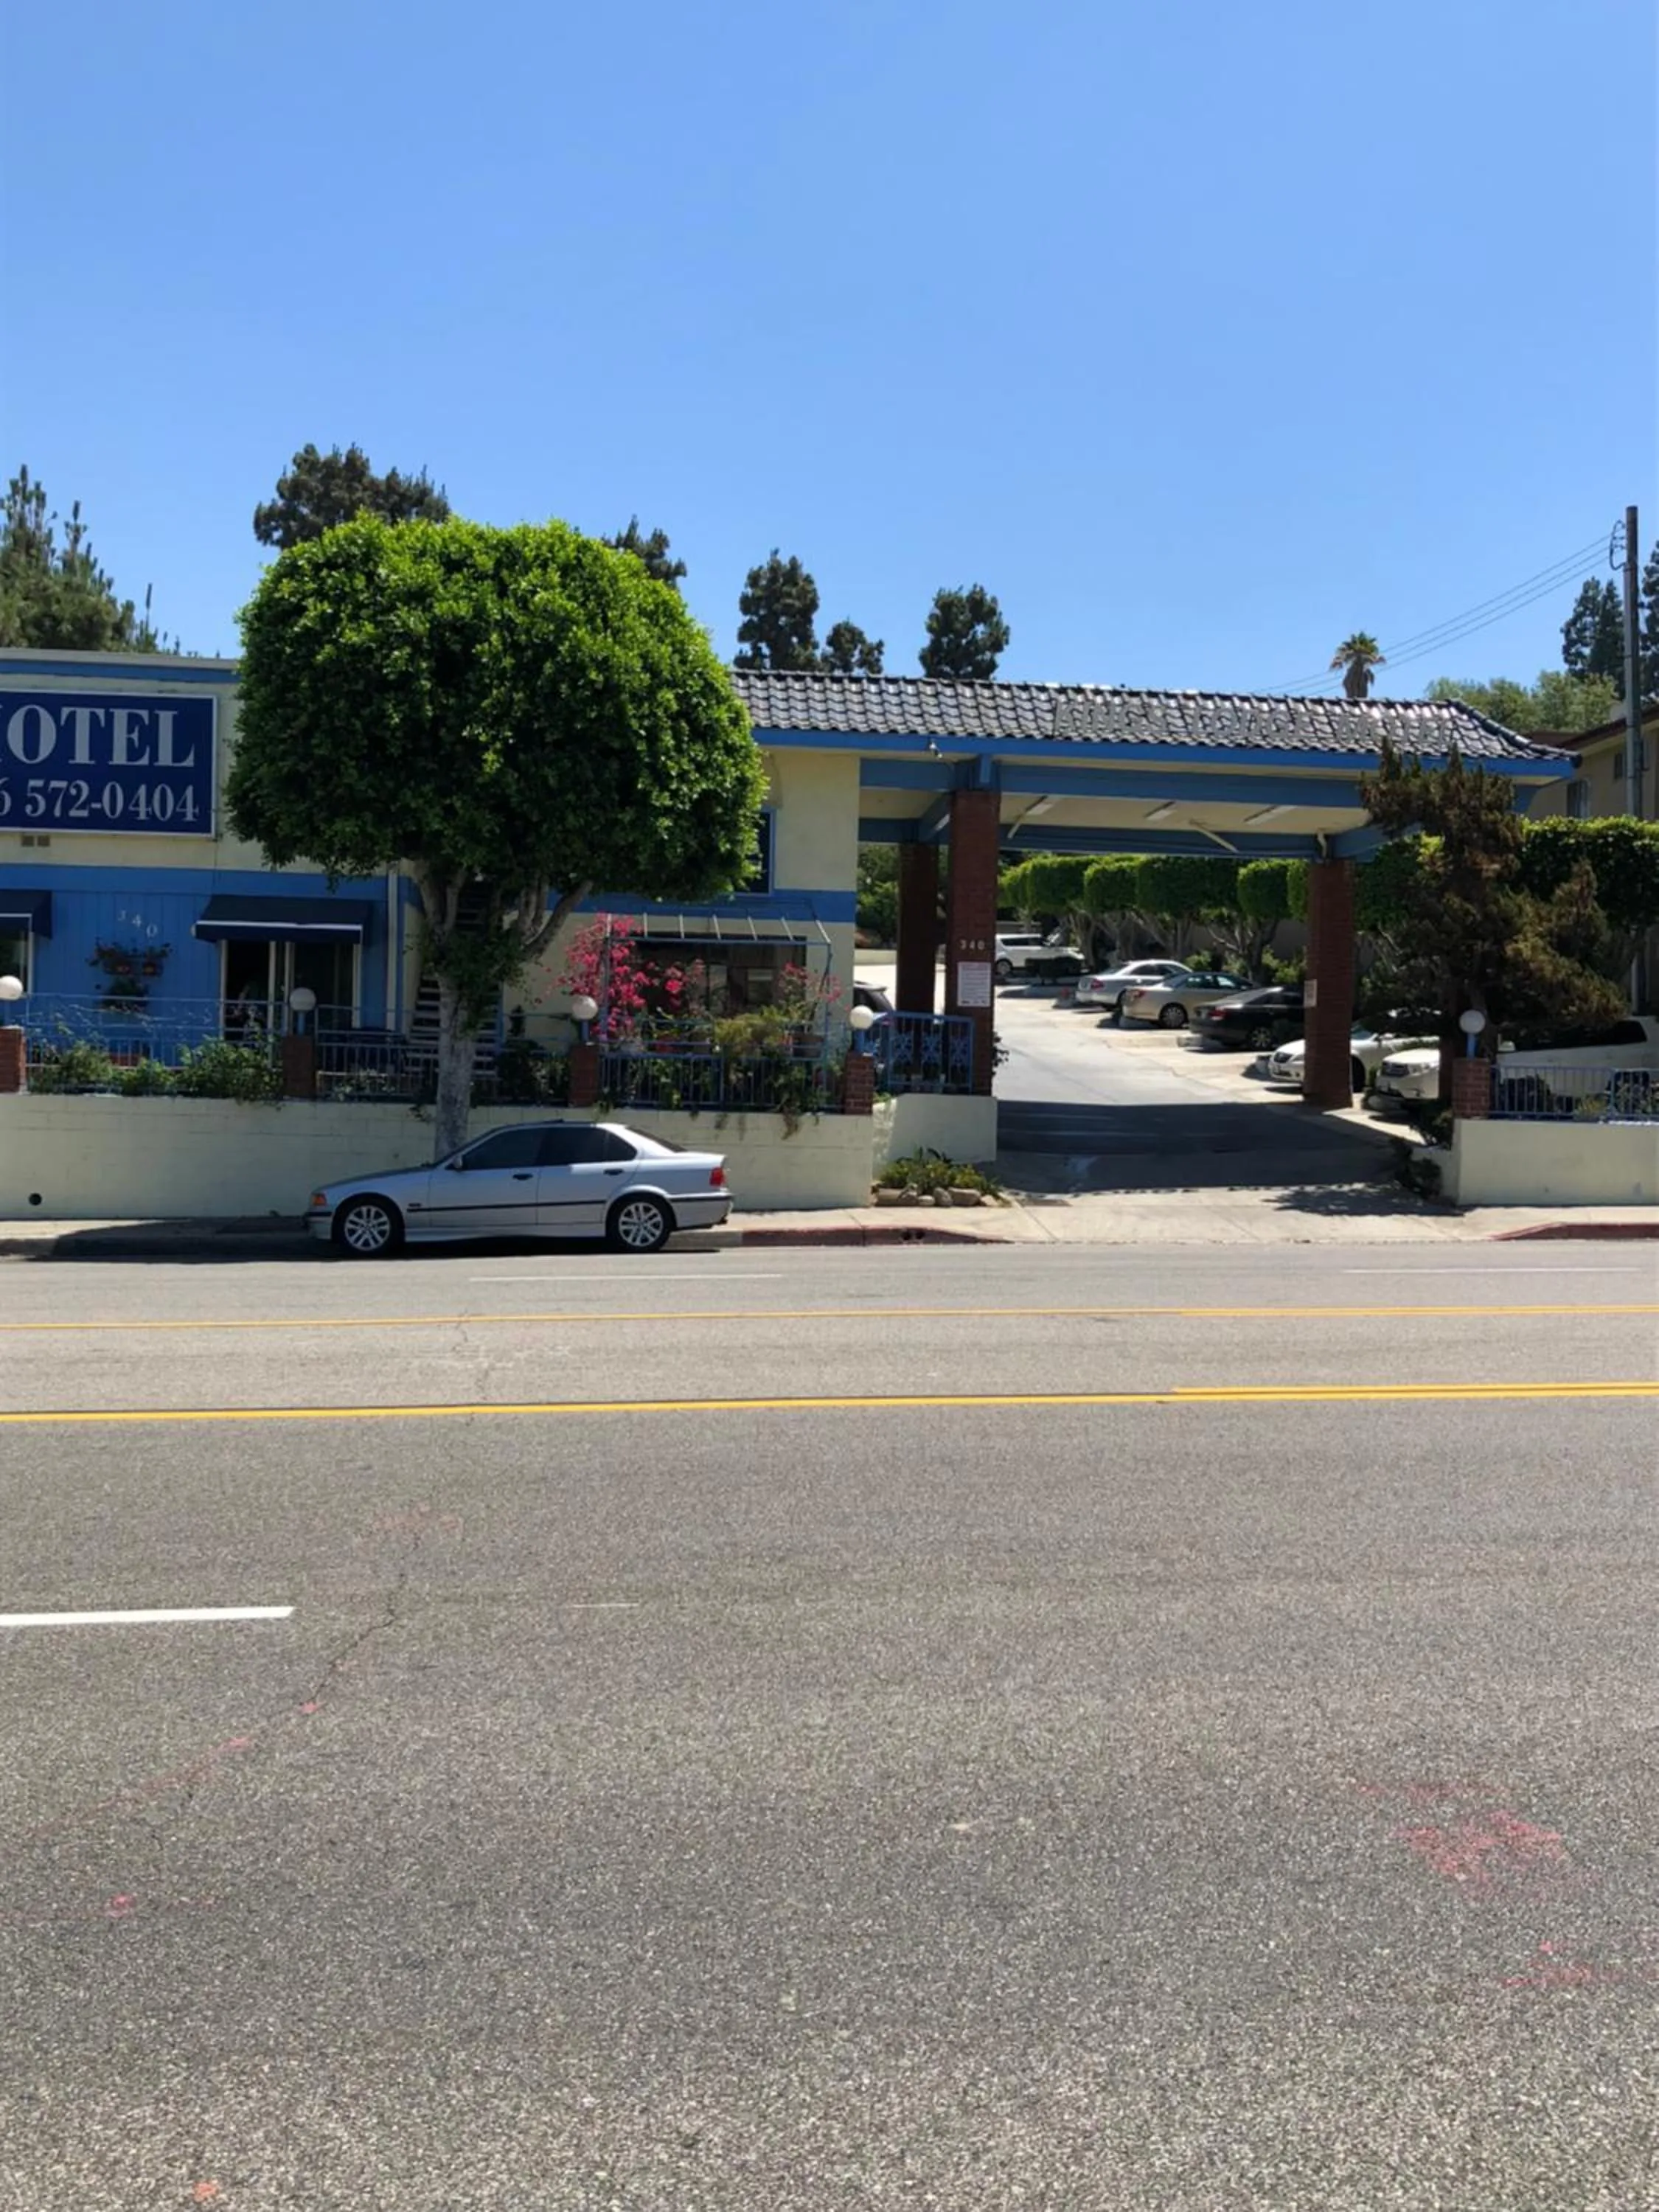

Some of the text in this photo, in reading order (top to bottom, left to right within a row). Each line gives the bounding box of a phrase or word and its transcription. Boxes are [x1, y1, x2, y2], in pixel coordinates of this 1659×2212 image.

[0, 704, 195, 767] OTEL
[25, 779, 200, 821] 572-0404
[960, 939, 985, 950] 340
